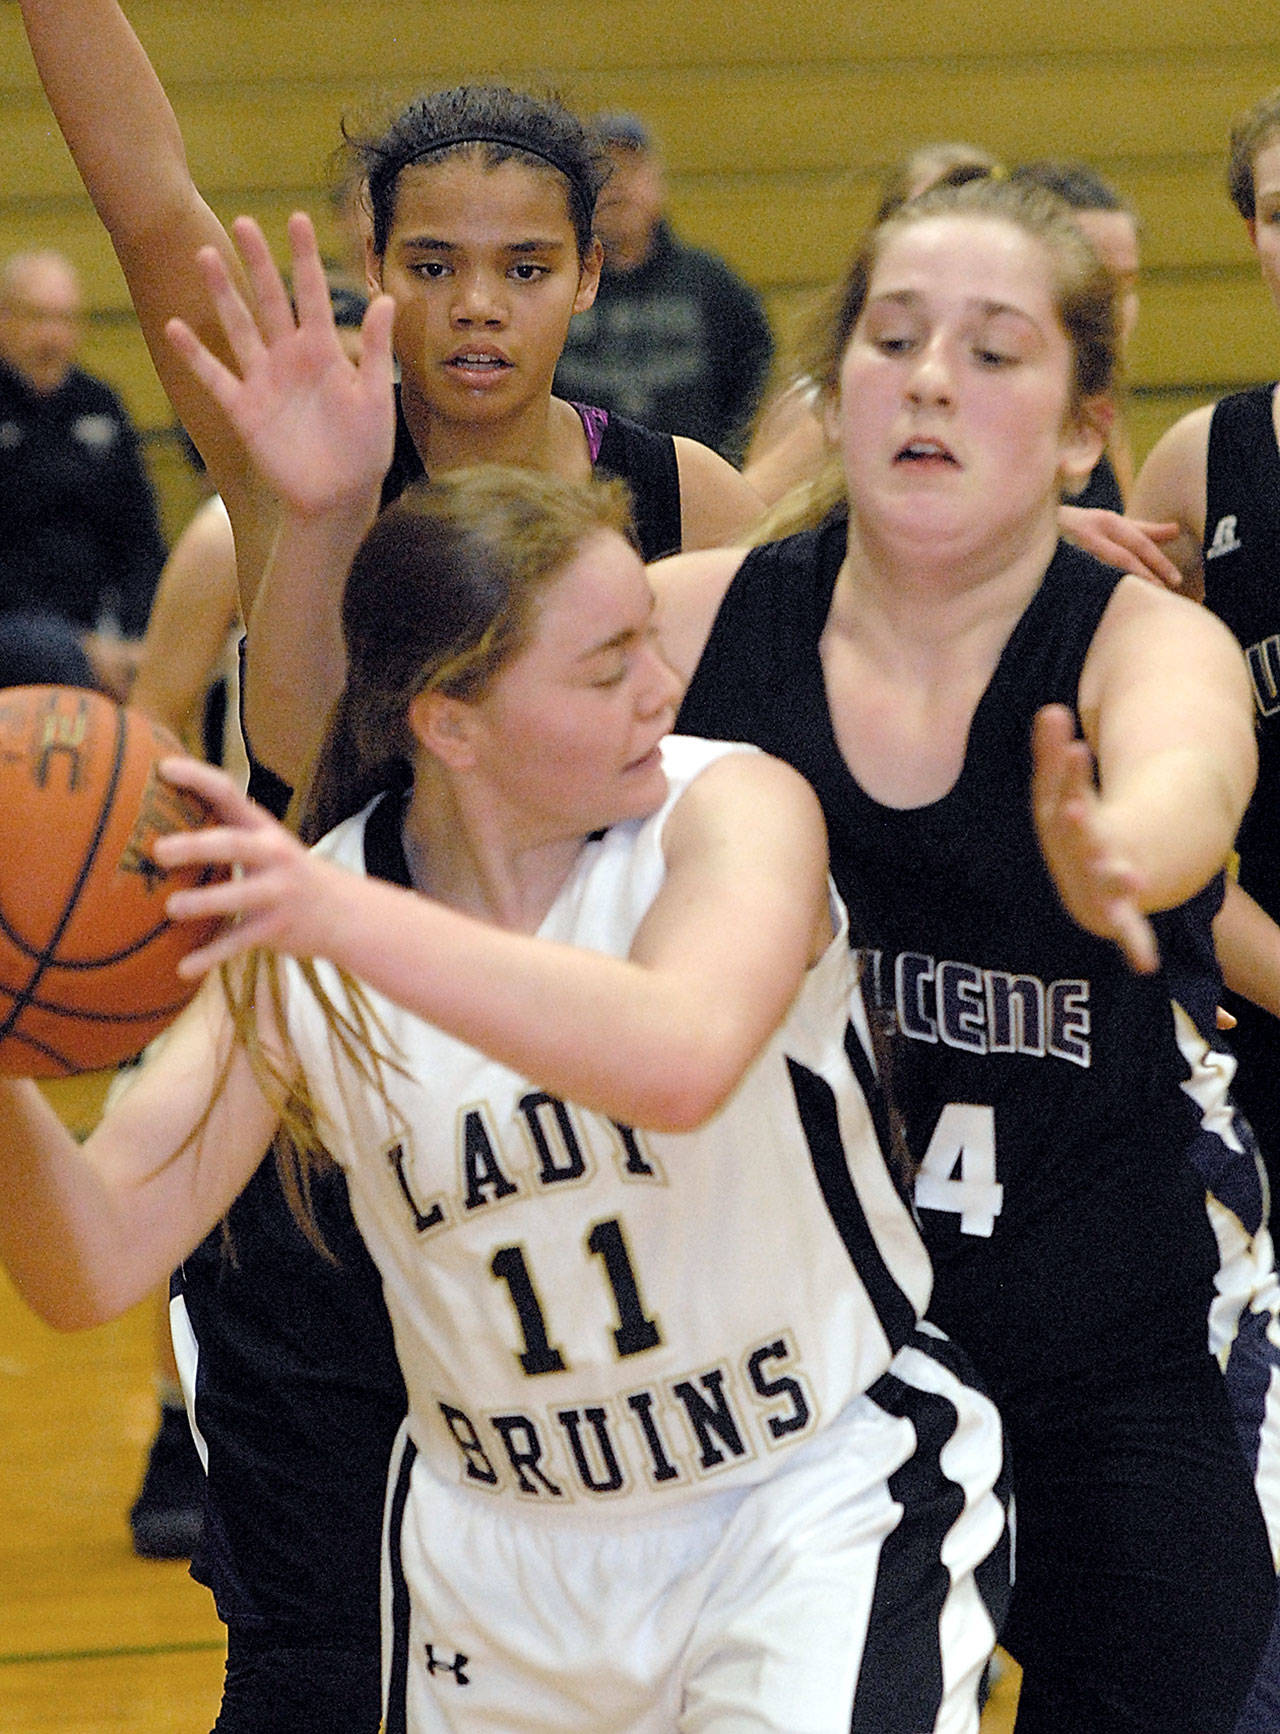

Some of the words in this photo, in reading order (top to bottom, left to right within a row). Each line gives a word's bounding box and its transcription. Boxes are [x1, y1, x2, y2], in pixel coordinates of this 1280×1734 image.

[914, 1103, 1004, 1238] 4
[490, 1217, 664, 1376] 11
[436, 1337, 812, 1498] BRUINS
